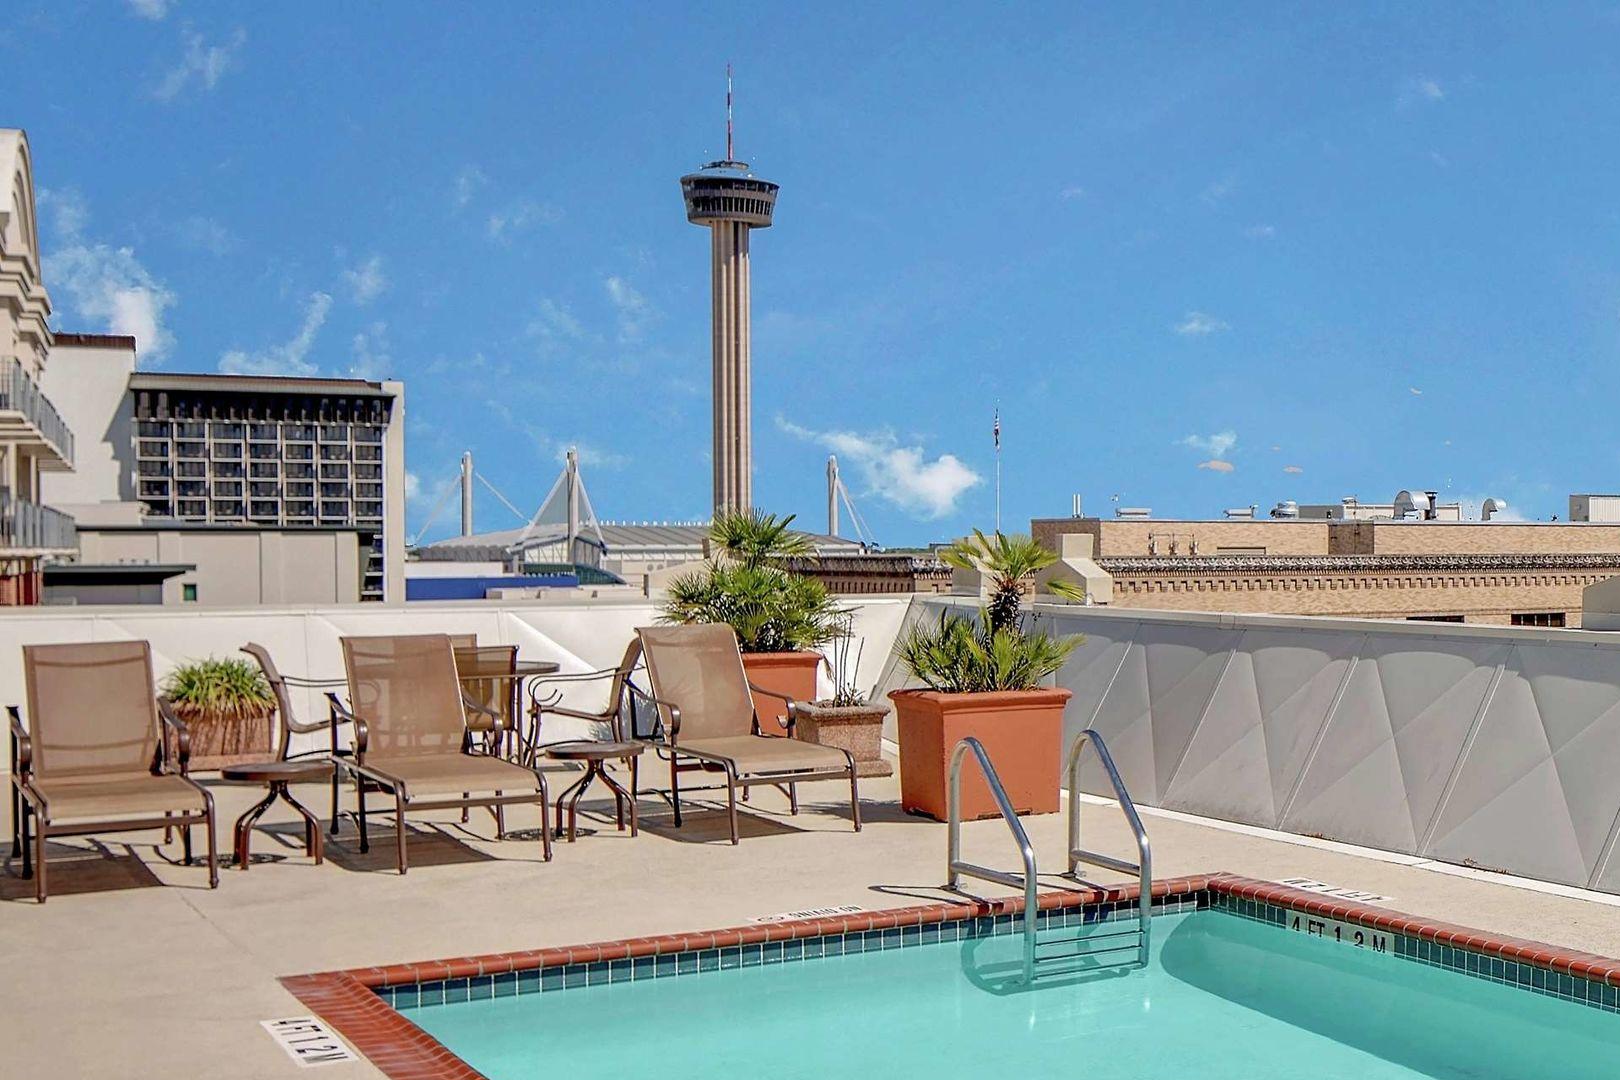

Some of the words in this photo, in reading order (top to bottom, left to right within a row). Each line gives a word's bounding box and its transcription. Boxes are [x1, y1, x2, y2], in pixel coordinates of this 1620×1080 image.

[1292, 916, 1300, 932] 4
[1308, 919, 1325, 937] FT
[1334, 926, 1341, 942] 1
[1354, 930, 1364, 949] 2
[1372, 934, 1386, 953] M
